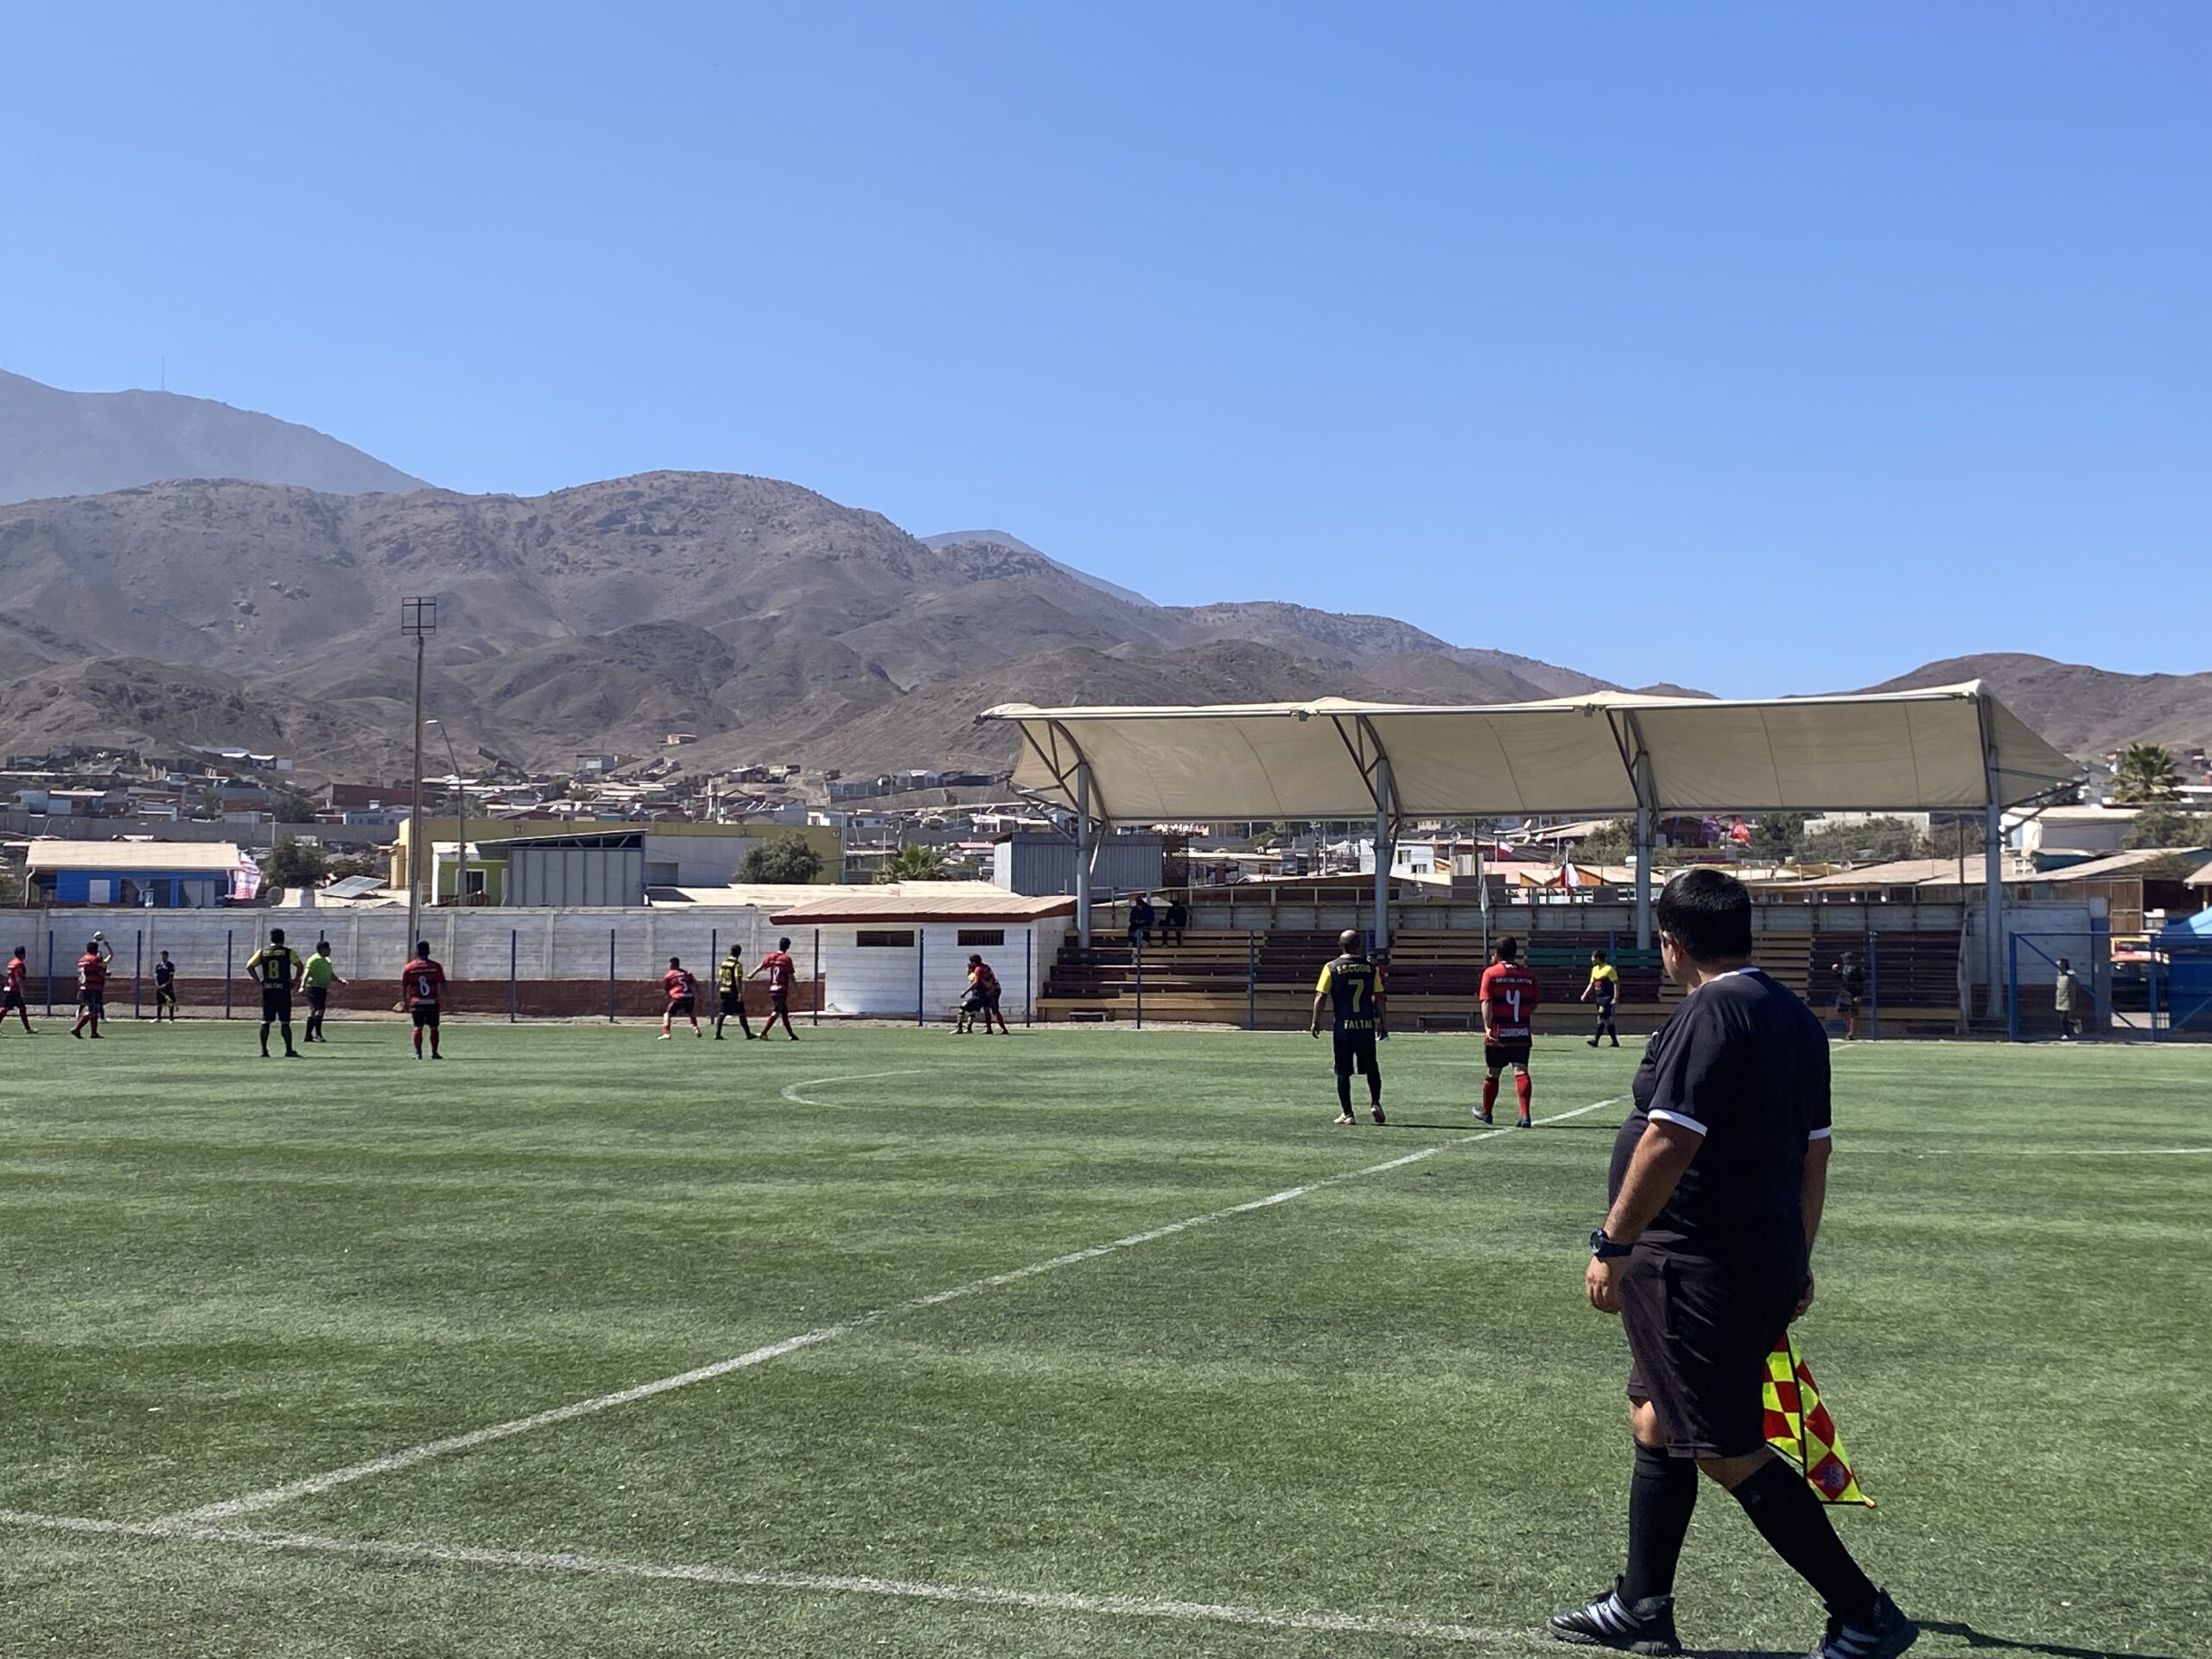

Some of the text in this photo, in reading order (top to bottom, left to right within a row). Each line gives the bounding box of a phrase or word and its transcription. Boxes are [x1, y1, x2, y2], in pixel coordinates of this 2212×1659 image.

[269, 959, 279, 979] 8
[418, 976, 429, 995] 8
[1348, 979, 1363, 1013] 7
[1506, 989, 1520, 1022] 4
